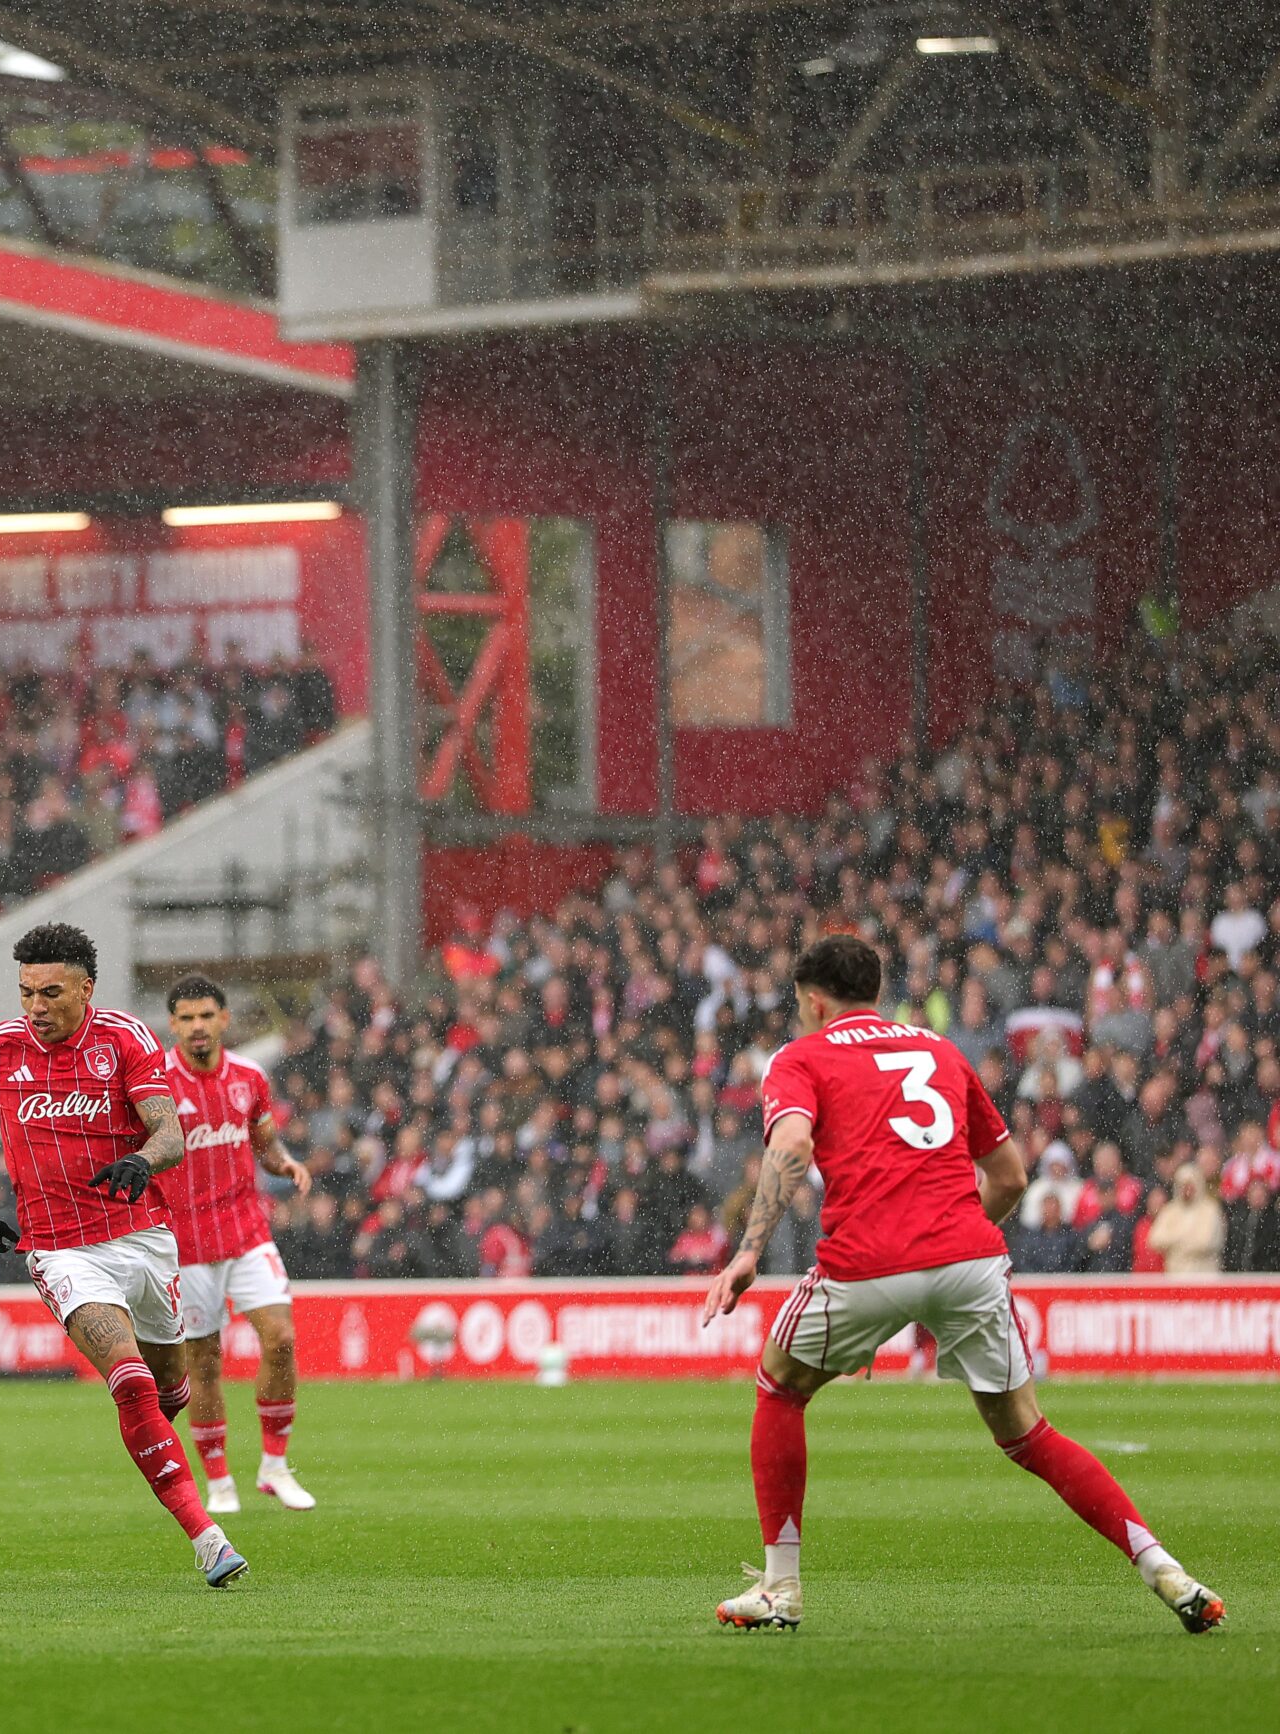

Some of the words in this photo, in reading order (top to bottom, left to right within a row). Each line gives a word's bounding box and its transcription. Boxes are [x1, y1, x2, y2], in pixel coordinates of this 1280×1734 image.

[17, 1091, 111, 1122] Bally's
[873, 1051, 954, 1150] 3
[139, 1438, 173, 1458] NFFC
